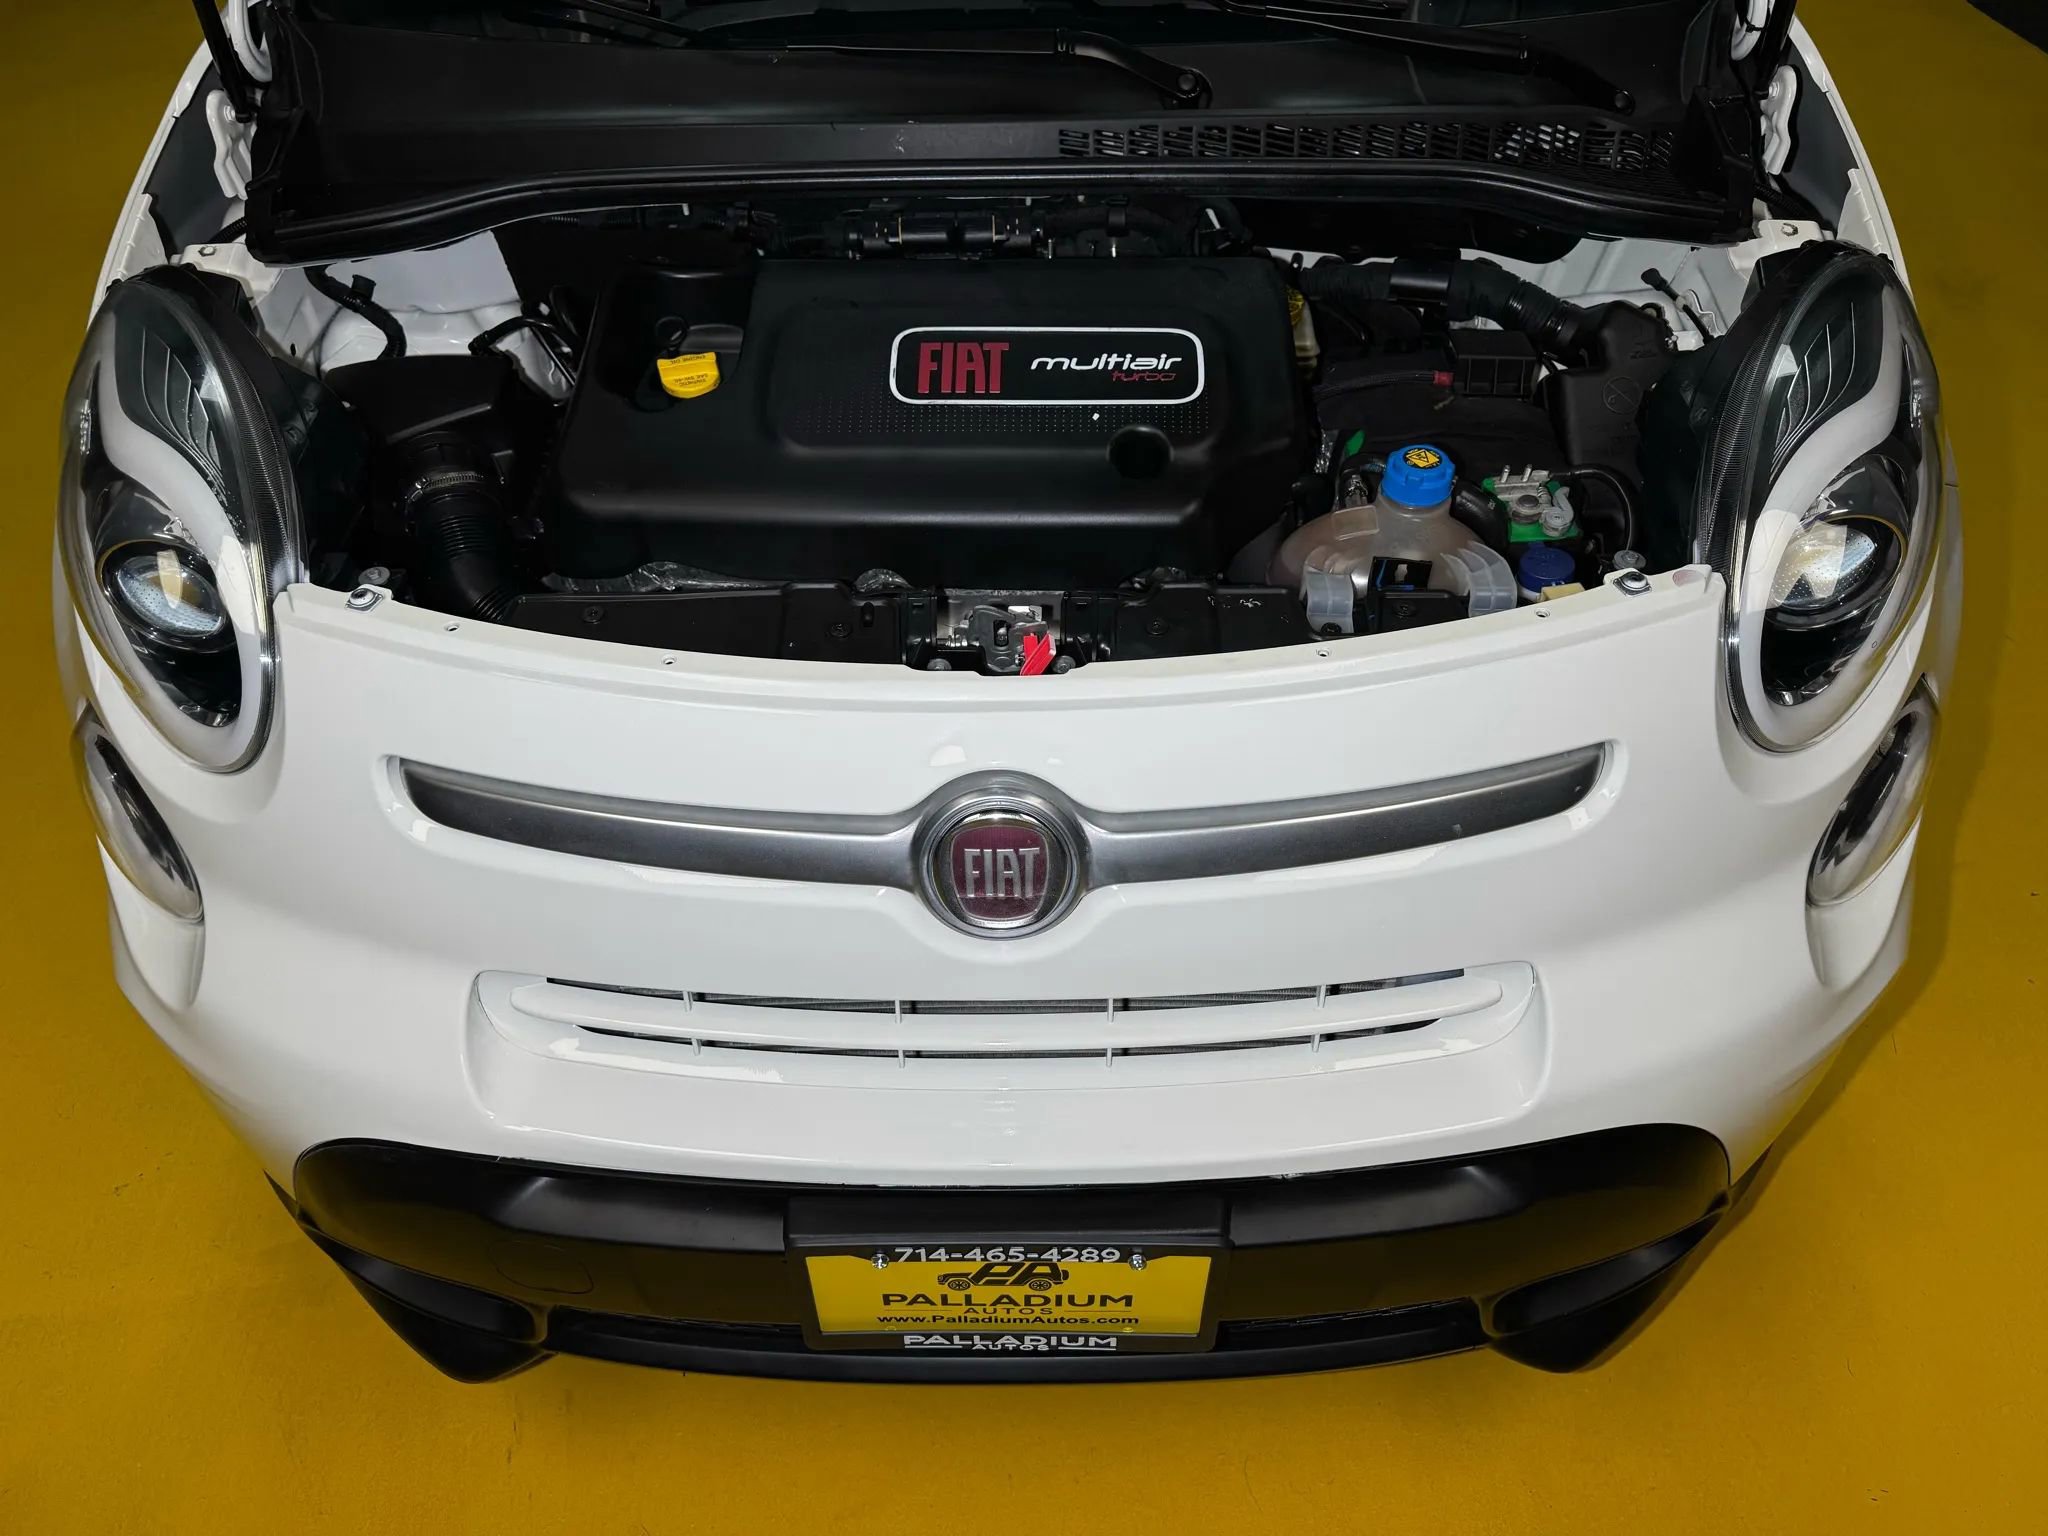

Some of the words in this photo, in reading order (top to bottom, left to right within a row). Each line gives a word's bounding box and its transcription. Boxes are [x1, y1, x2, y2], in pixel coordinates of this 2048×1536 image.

[918, 342, 1010, 394] FIAT
[1030, 353, 1182, 371] multiair
[1112, 370, 1176, 381] turbo
[964, 847, 1040, 898] FIAT
[895, 1247, 1121, 1262] 714-465-4289
[882, 1293, 1134, 1307] PALLADIUM
[963, 1307, 1053, 1315] AUTOS
[877, 1315, 1139, 1325] www.PalladiumAutos.com
[904, 1335, 1117, 1346] PALLADIUM
